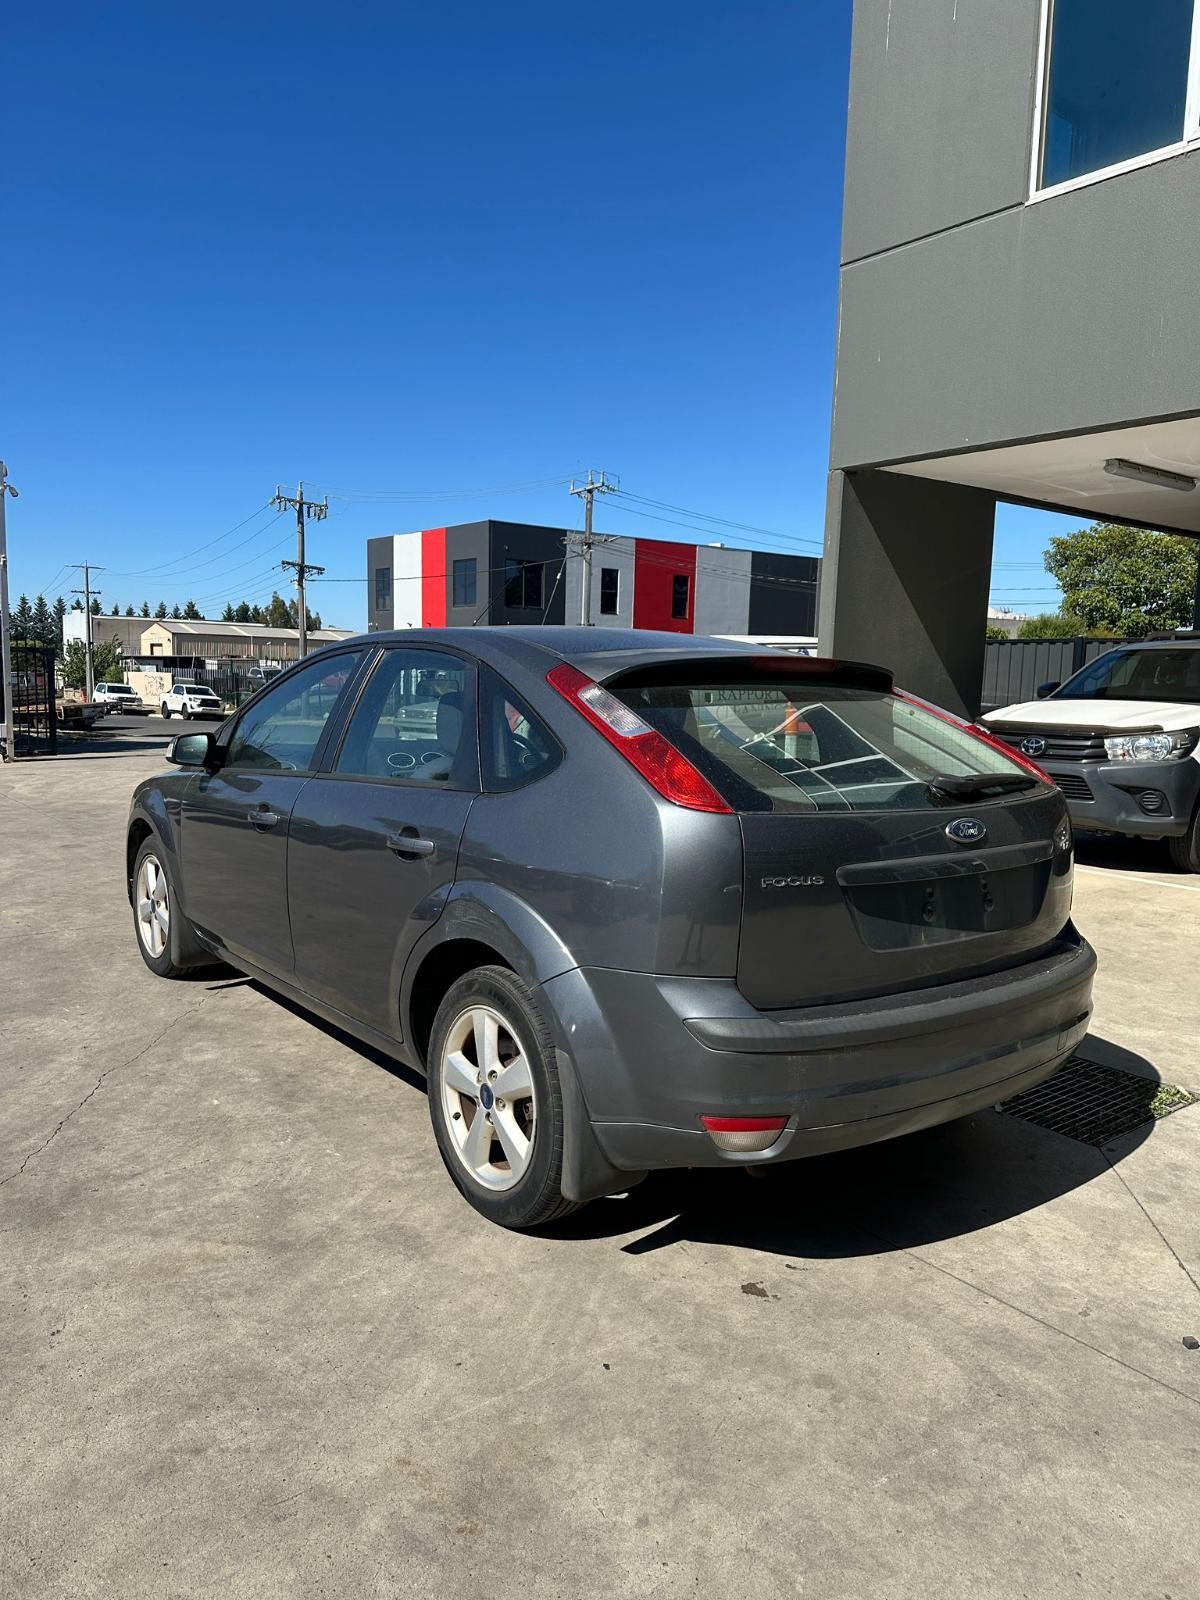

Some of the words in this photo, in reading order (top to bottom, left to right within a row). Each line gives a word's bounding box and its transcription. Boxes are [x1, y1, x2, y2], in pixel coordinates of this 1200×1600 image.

[718, 689, 781, 700] RAPPORT
[960, 822, 979, 836] Ford
[761, 876, 825, 888] FOCUS
